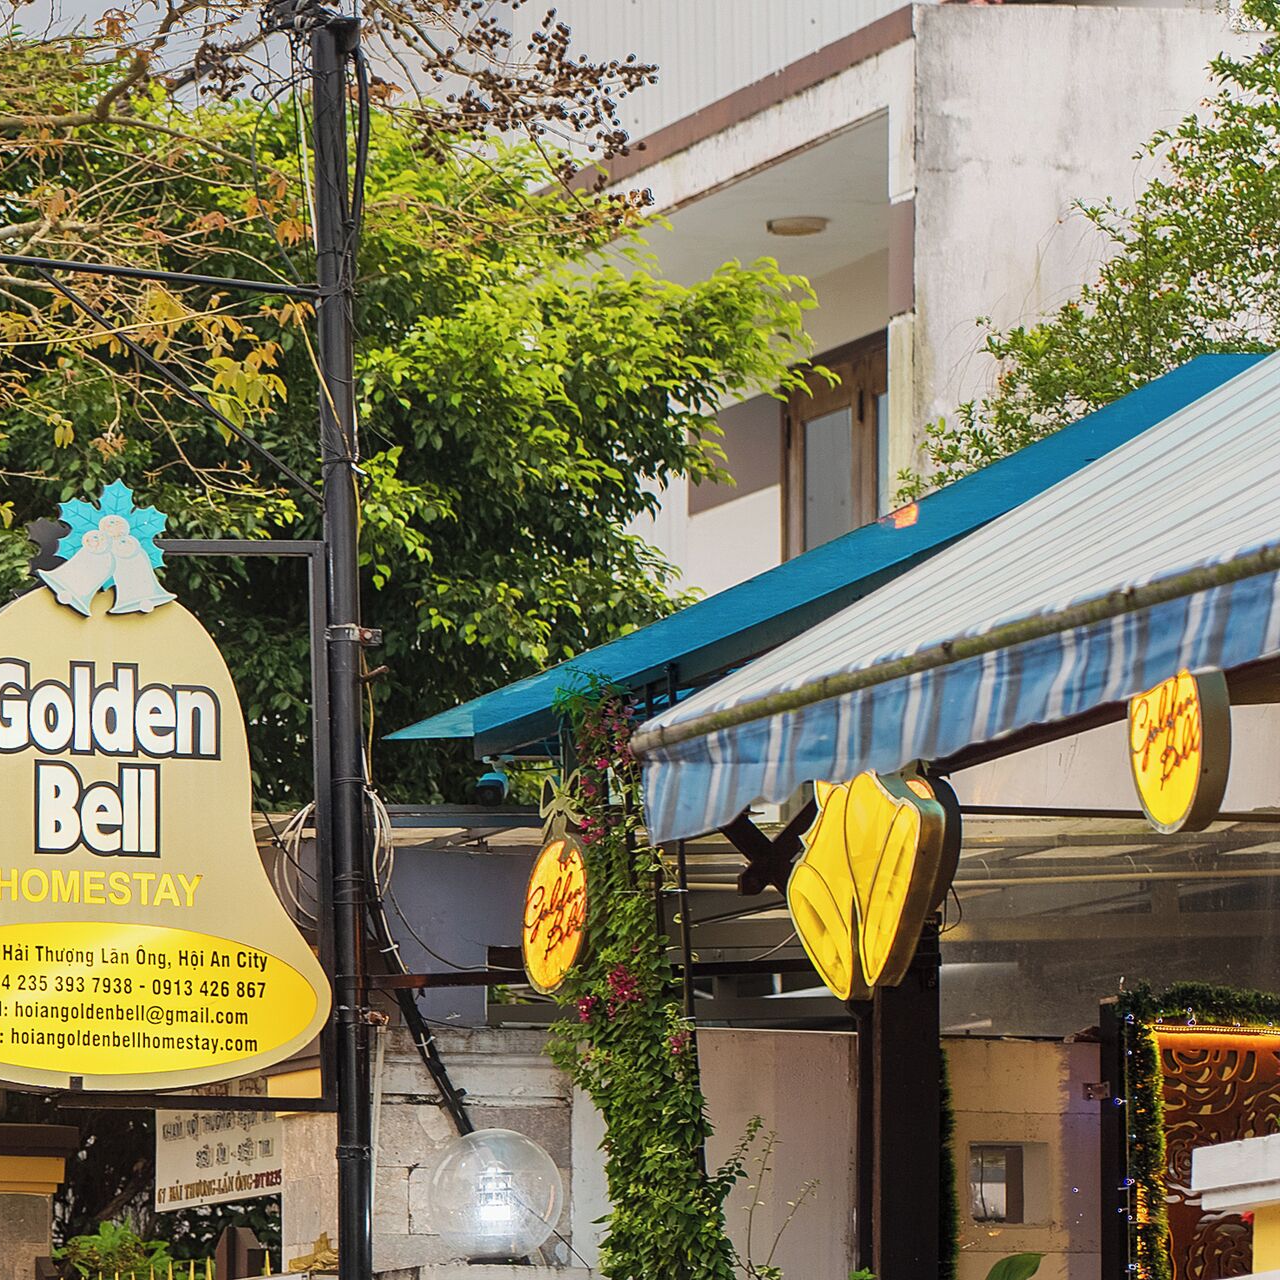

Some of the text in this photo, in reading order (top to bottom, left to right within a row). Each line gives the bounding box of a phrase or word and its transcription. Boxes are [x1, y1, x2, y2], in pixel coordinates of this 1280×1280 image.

[34, 759, 160, 858] Bell
[2, 943, 29, 962] Hải
[35, 945, 94, 968] Thượng
[136, 944, 172, 970] Ông,
[178, 949, 204, 971] Hội
[210, 950, 230, 968] An
[236, 951, 268, 973] City
[17, 974, 48, 992] 235
[54, 976, 85, 993] 393
[92, 977, 133, 994] 7938
[152, 979, 193, 996] 0913
[199, 980, 230, 998] 426
[236, 982, 267, 999] 867
[15, 1001, 249, 1026] hoiangoldenbell@gmail.com
[11, 1027, 259, 1055] hoiangoldenbellhomestay.com
